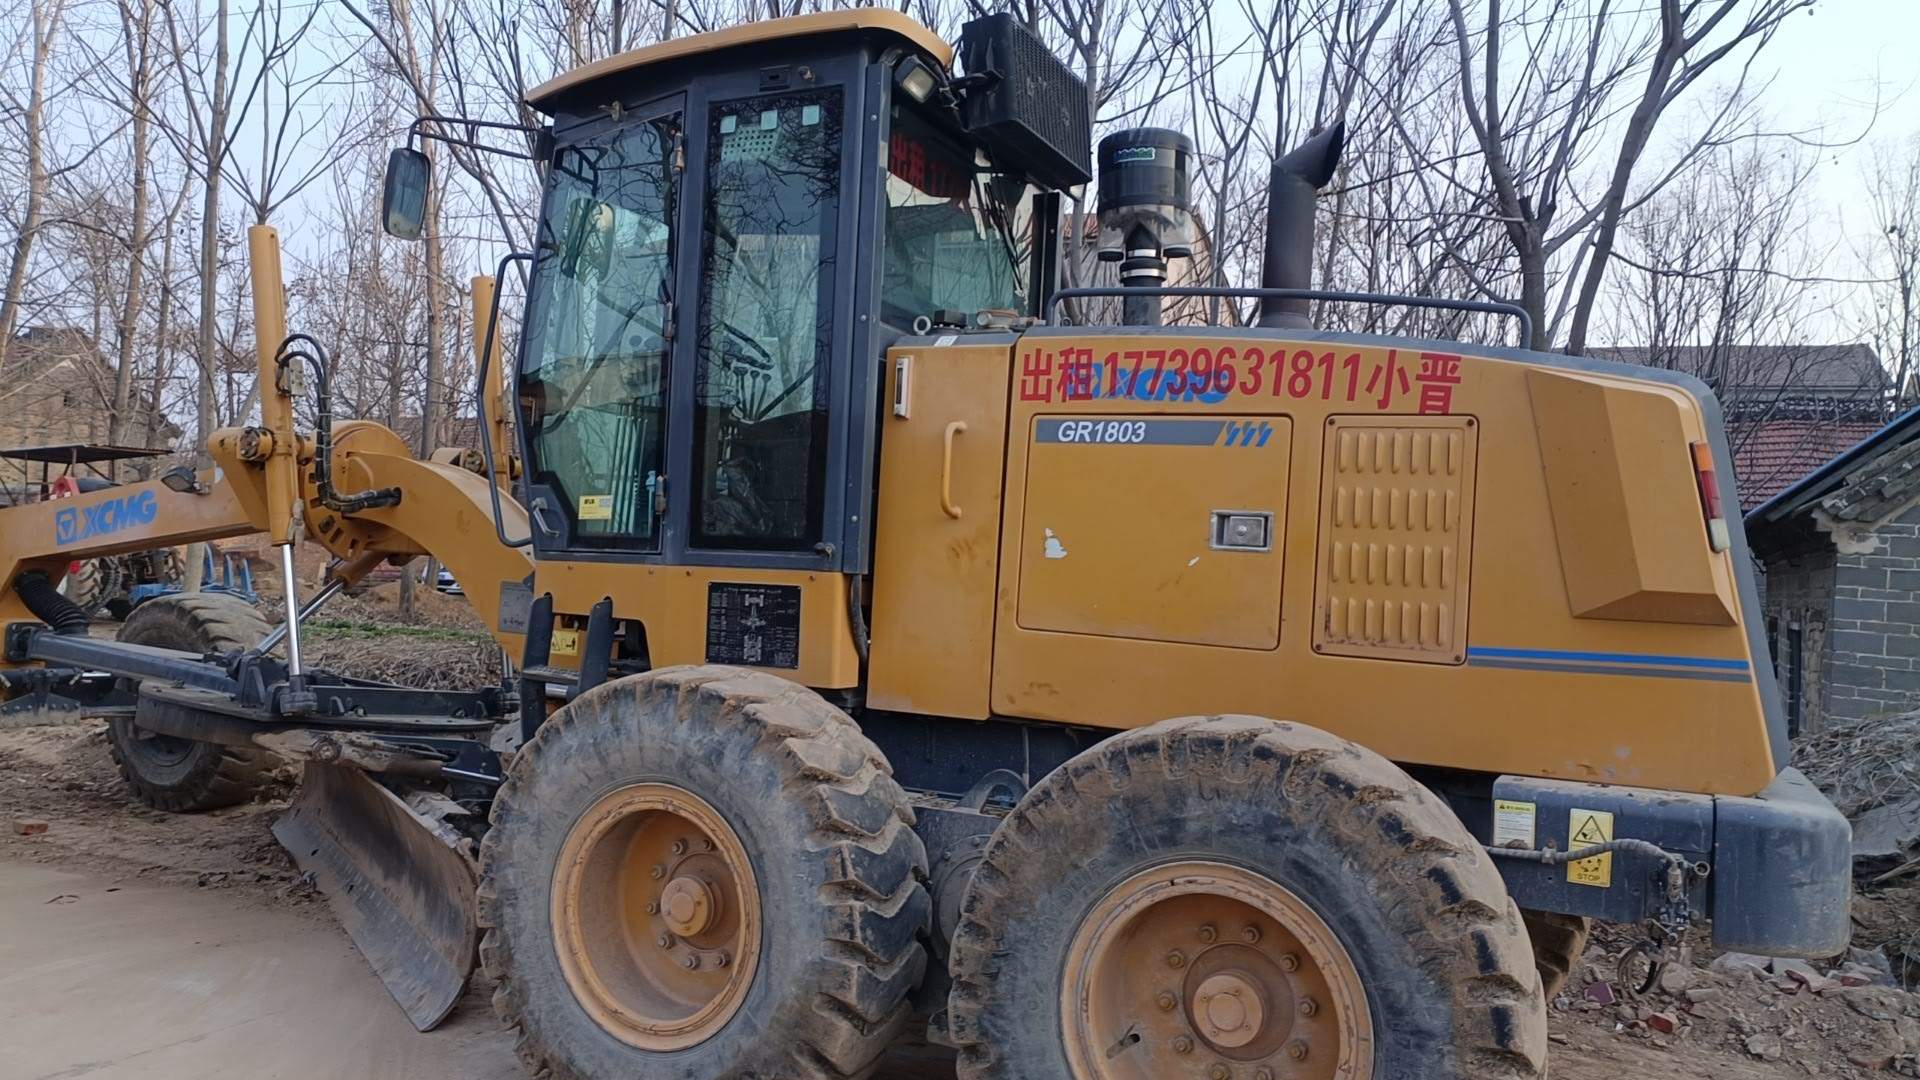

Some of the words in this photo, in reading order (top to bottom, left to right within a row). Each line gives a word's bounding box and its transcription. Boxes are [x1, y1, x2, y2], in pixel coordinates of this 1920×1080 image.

[1058, 421, 1146, 443] GR1803
[77, 489, 157, 538] XCMG
[1576, 873, 1601, 882] STOP
